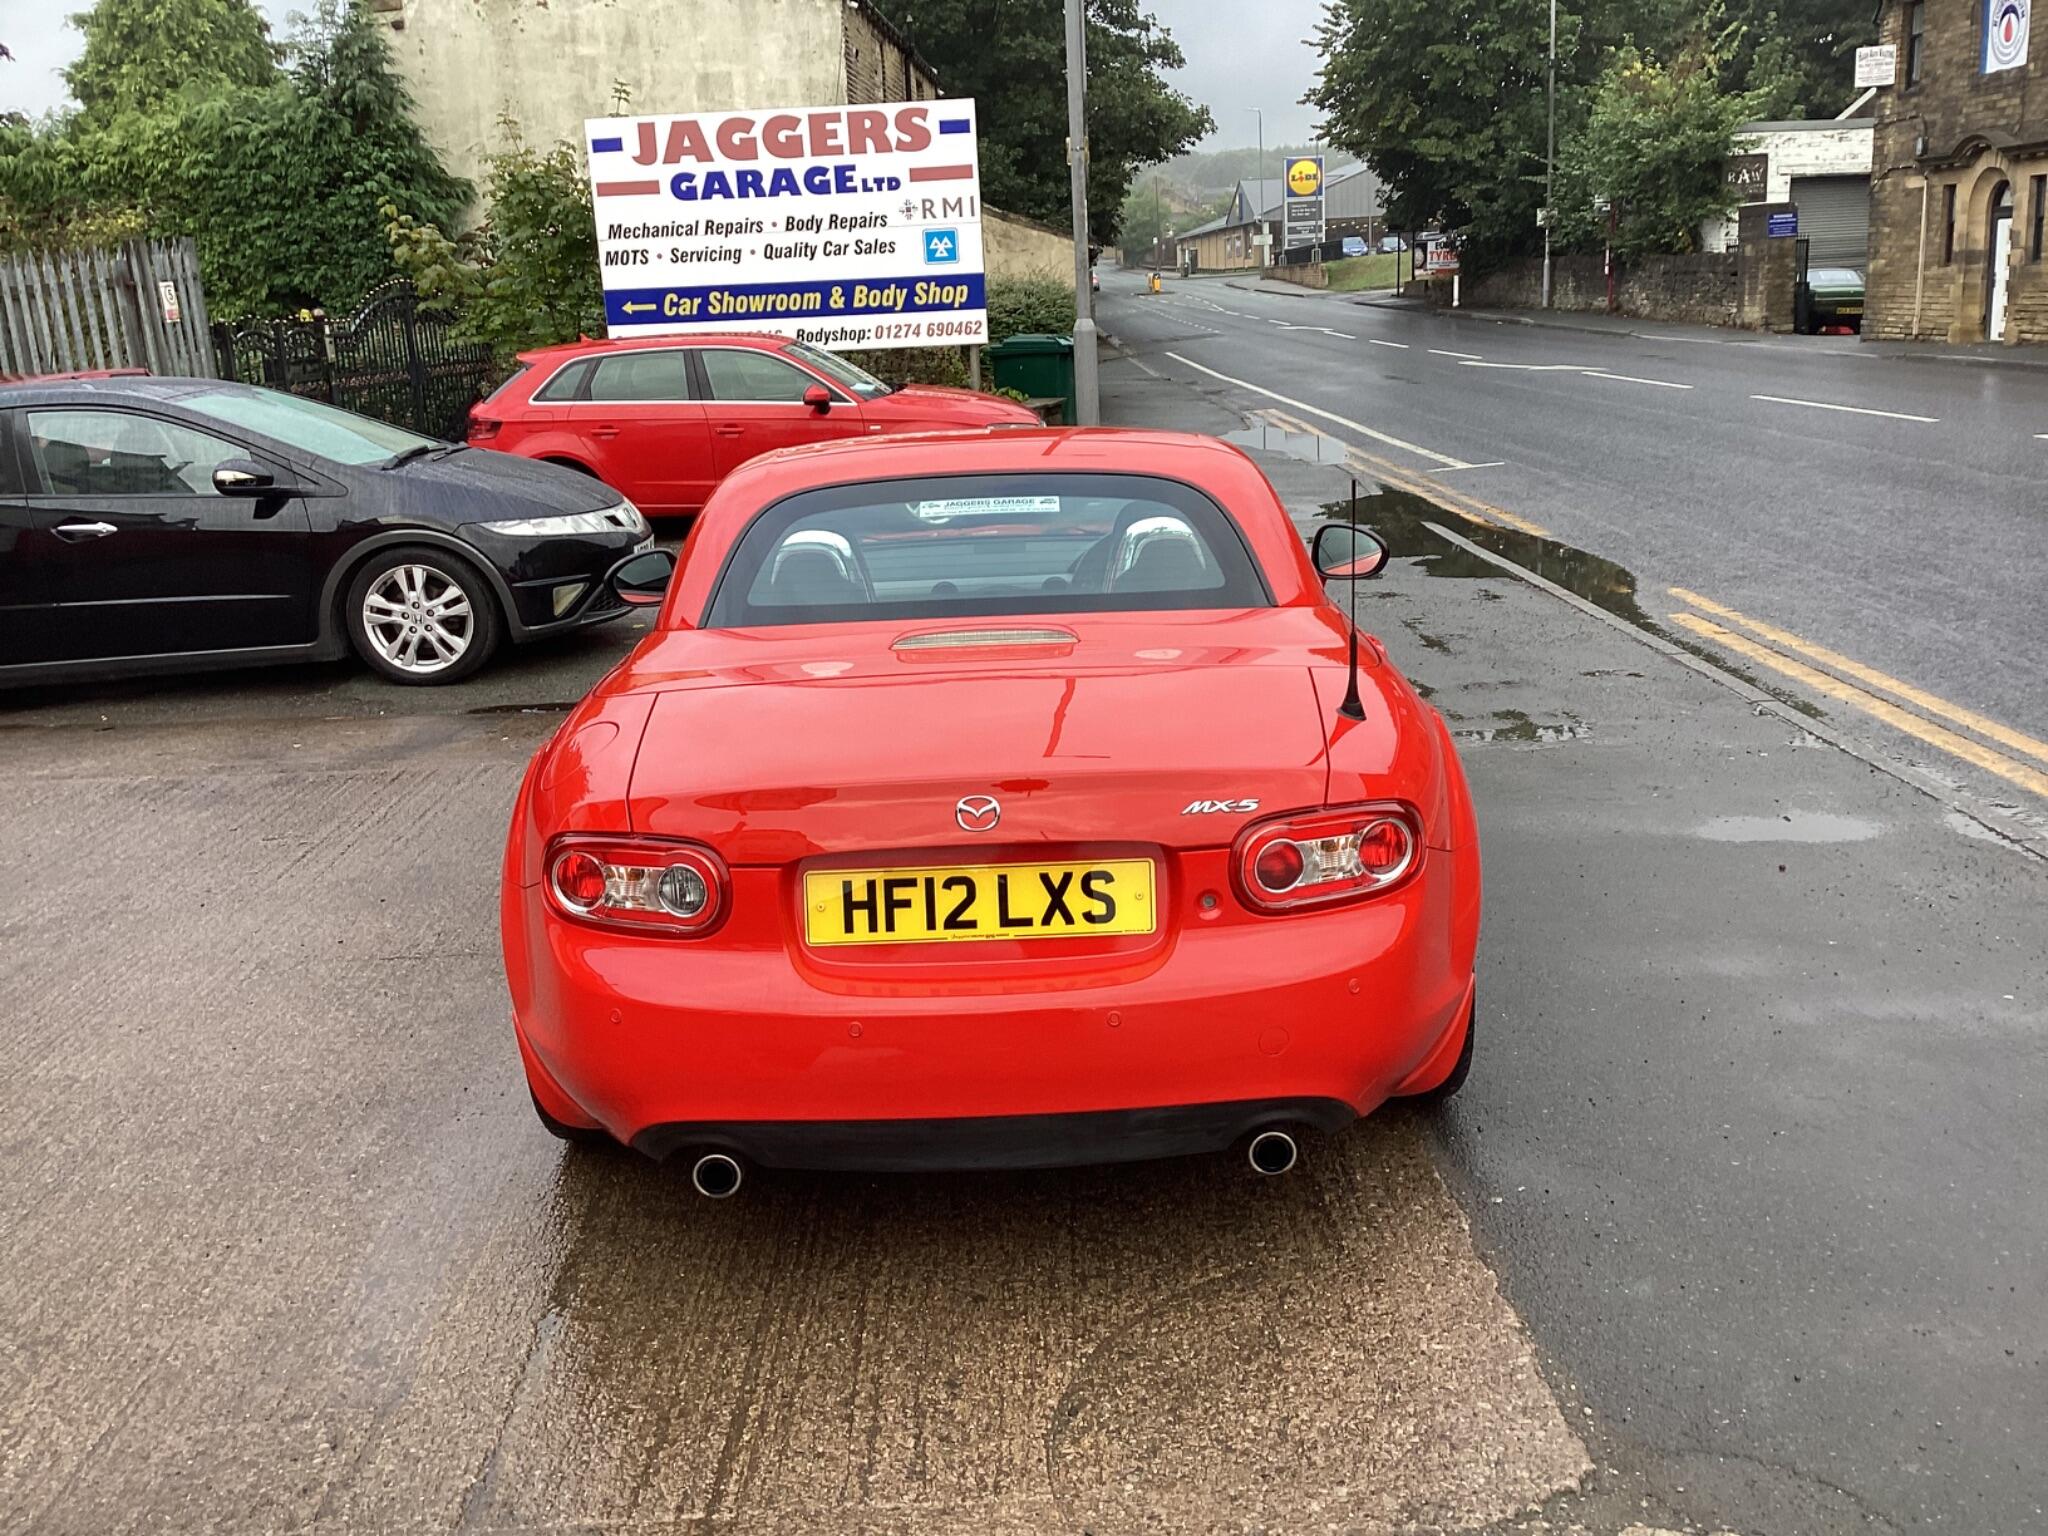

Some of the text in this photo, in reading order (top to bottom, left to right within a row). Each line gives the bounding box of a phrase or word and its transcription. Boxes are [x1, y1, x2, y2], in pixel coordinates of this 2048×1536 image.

[632, 107, 932, 166] JAGGERS
[670, 164, 902, 201] GARAGE LTD
[921, 196, 975, 219] RMI
[608, 212, 888, 240] Mechanical Repairs Body Repairs
[605, 238, 896, 267] MOTS Servicing Quality Car Sales
[663, 281, 969, 317] Car Showroom & Body Shop
[797, 327, 871, 346] Bodyshop:
[875, 324, 922, 340] 01274
[927, 320, 983, 337] 690462
[1181, 799, 1260, 815] MX-5
[843, 871, 1117, 934] HF12 LXS
